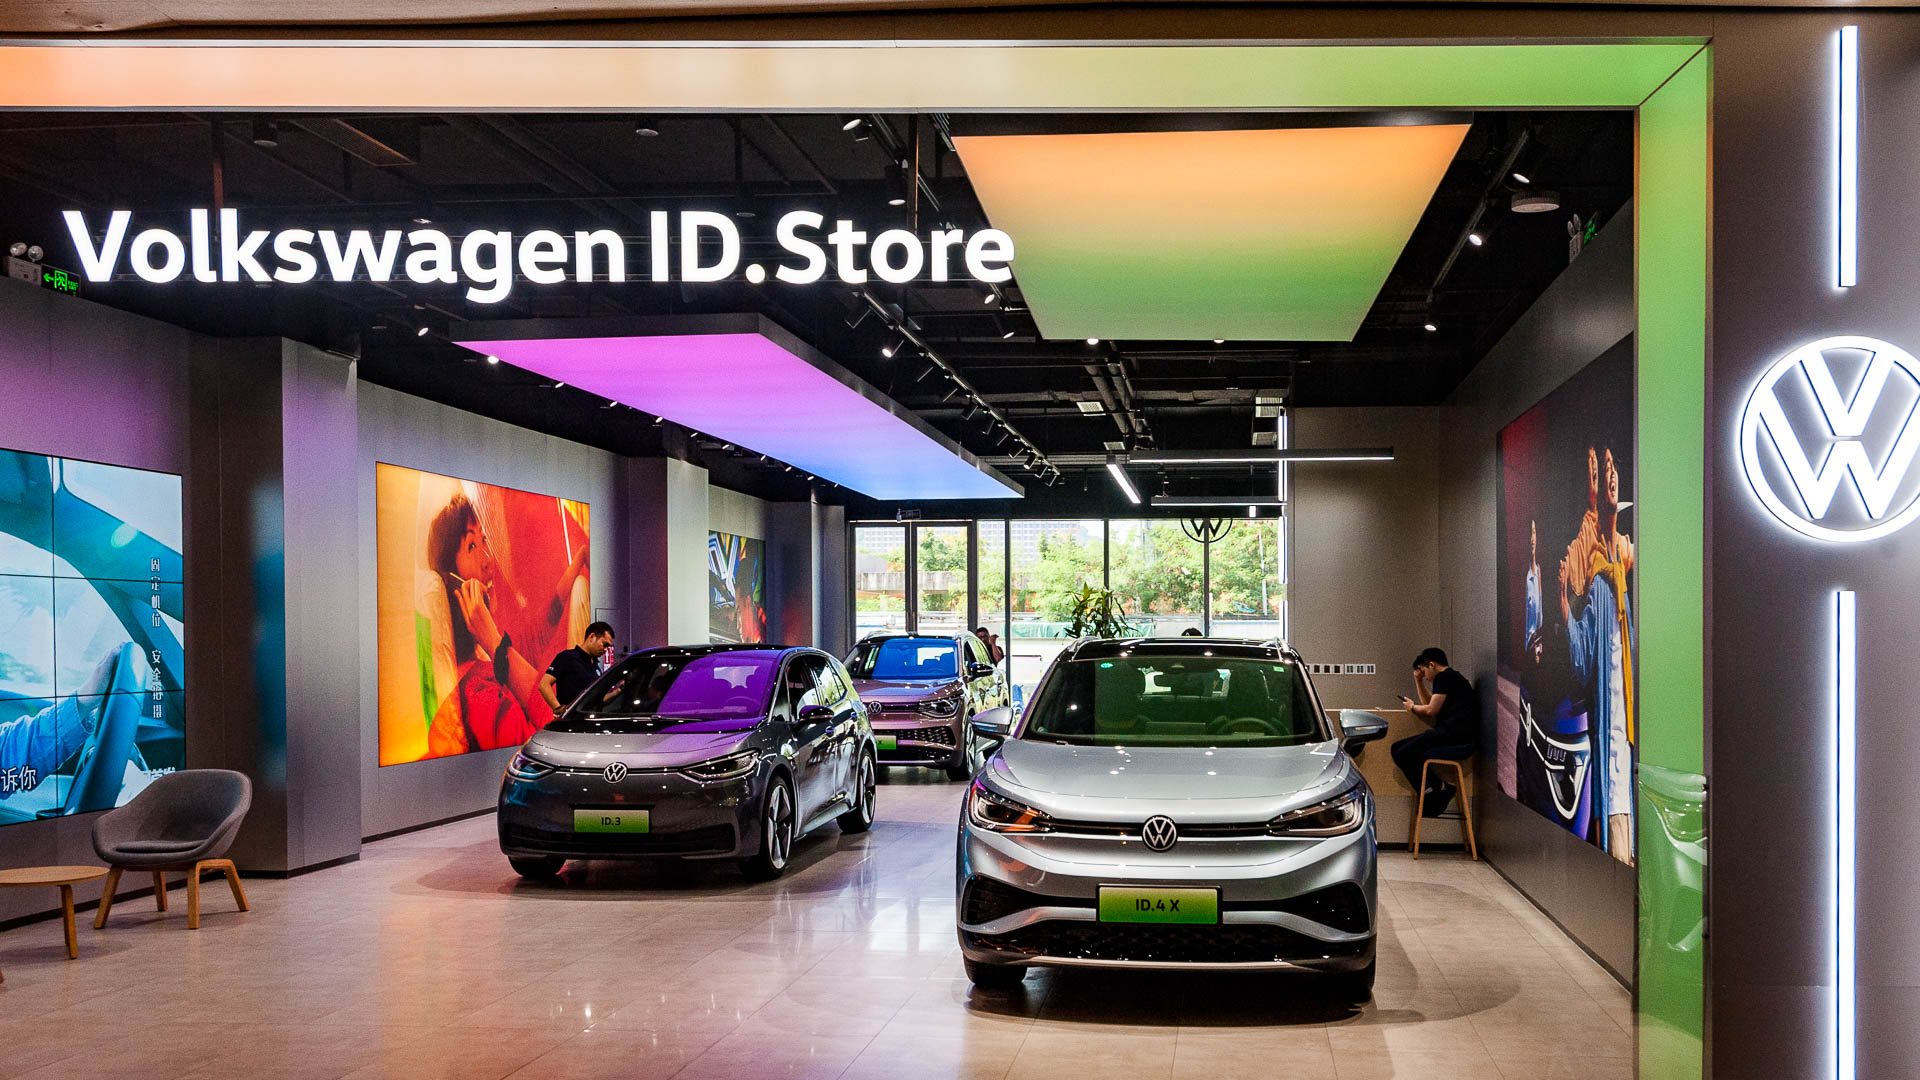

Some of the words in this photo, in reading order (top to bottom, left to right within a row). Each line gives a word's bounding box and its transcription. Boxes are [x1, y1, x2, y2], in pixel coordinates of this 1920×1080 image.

[63, 208, 625, 304] Volkswagen
[650, 210, 1015, 284] ID.Store
[1747, 337, 1920, 532] VW
[151, 558, 161, 628] 固定机位
[1, 766, 36, 791] 诉你
[601, 817, 621, 826] ID.3
[1143, 817, 1176, 849] VW
[1135, 899, 1166, 911] ID.4
[1170, 899, 1180, 912] X
